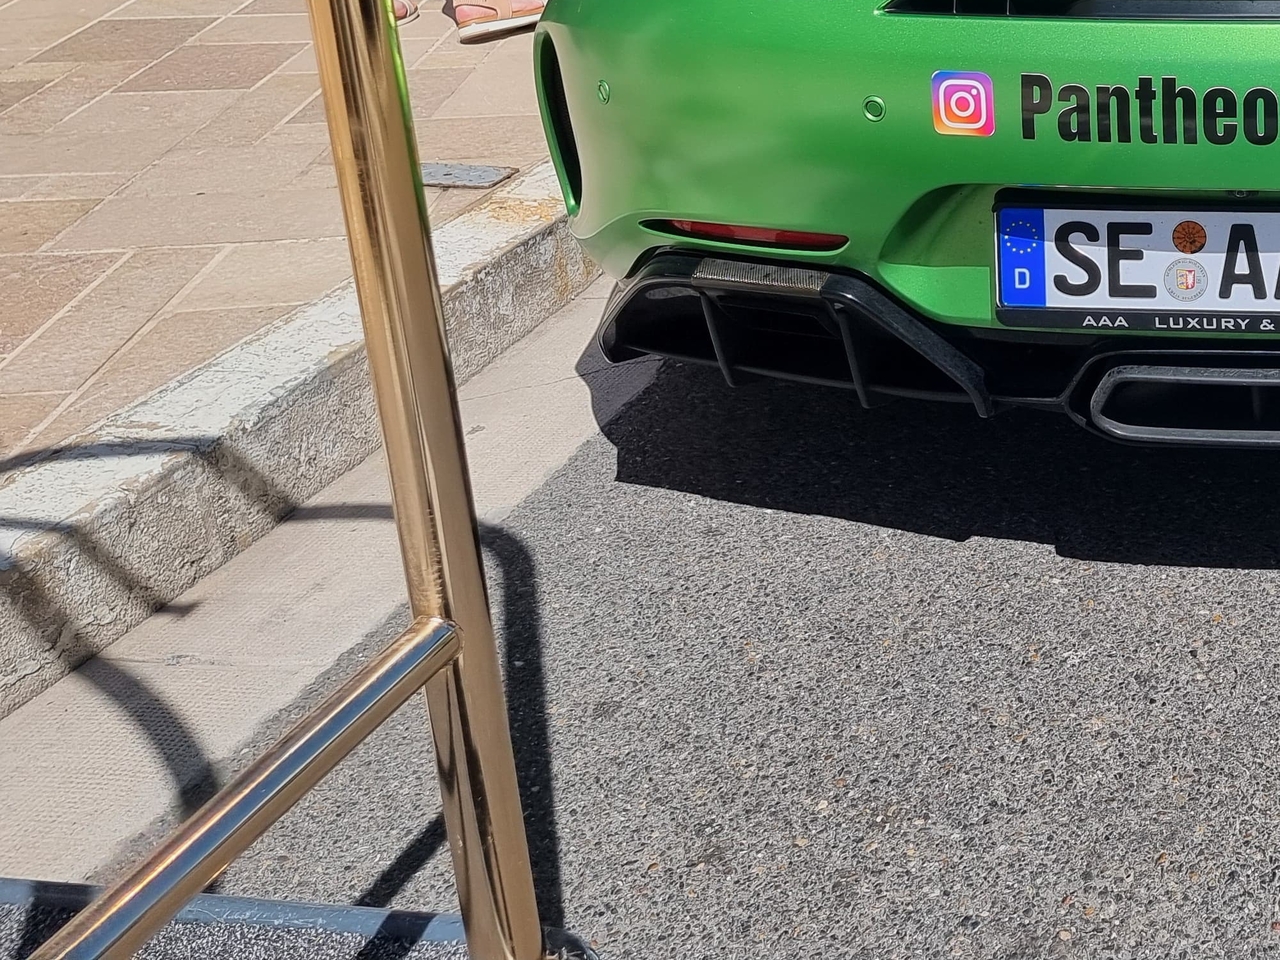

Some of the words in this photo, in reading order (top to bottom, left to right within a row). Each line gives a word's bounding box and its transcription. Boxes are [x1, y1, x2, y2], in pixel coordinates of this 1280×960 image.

[1014, 268, 1031, 289] D
[1053, 221, 1157, 298] SE
[1082, 315, 1129, 328] AAA
[1155, 316, 1250, 330] LUXURY
[1259, 319, 1275, 331] &
